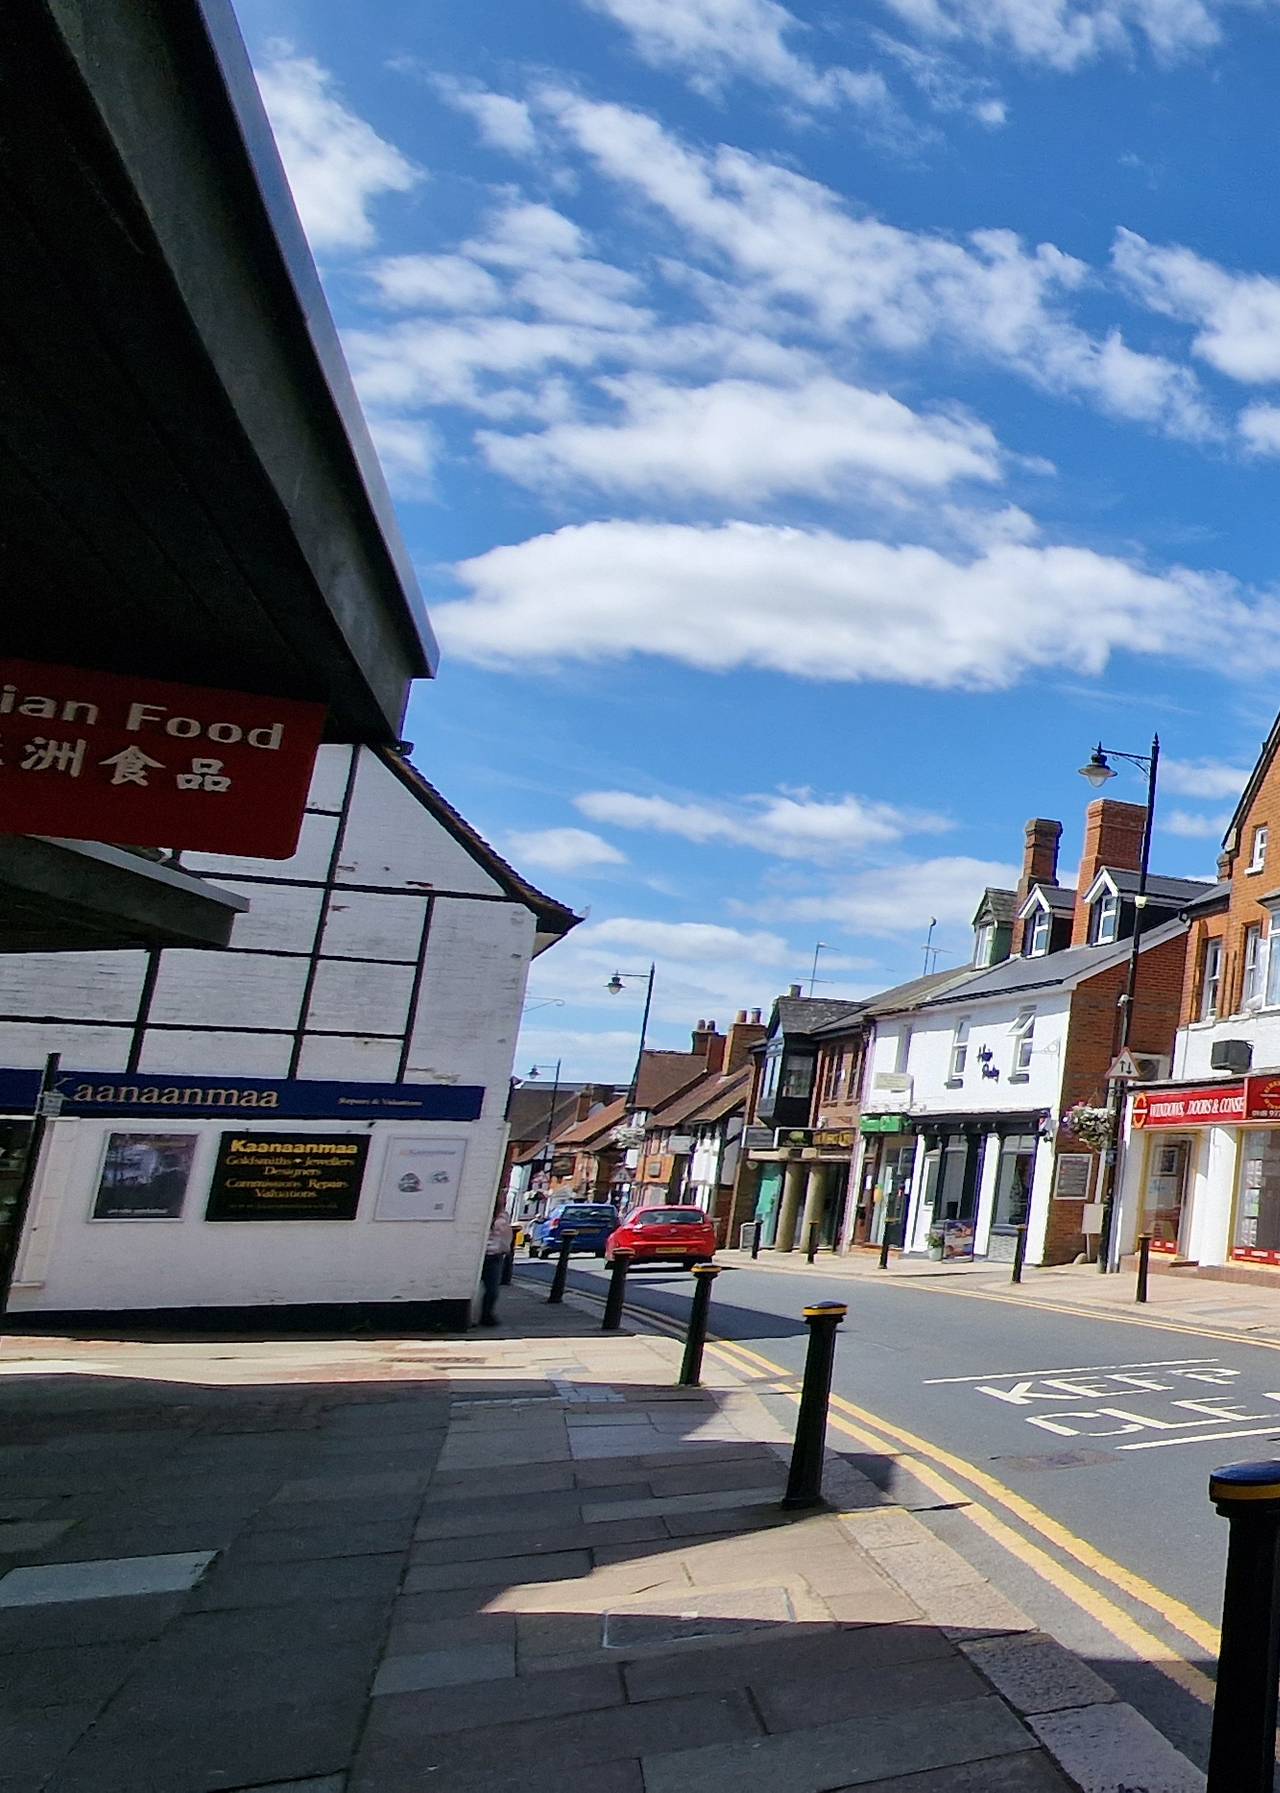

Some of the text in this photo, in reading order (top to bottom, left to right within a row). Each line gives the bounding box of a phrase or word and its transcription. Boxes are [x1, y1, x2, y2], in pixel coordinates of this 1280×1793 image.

[125, 702, 285, 751] Food
[0, 736, 232, 792] 洲食品
[1187, 1099, 1212, 1115] DOORS
[231, 1139, 358, 1154] Kaanaanmaa
